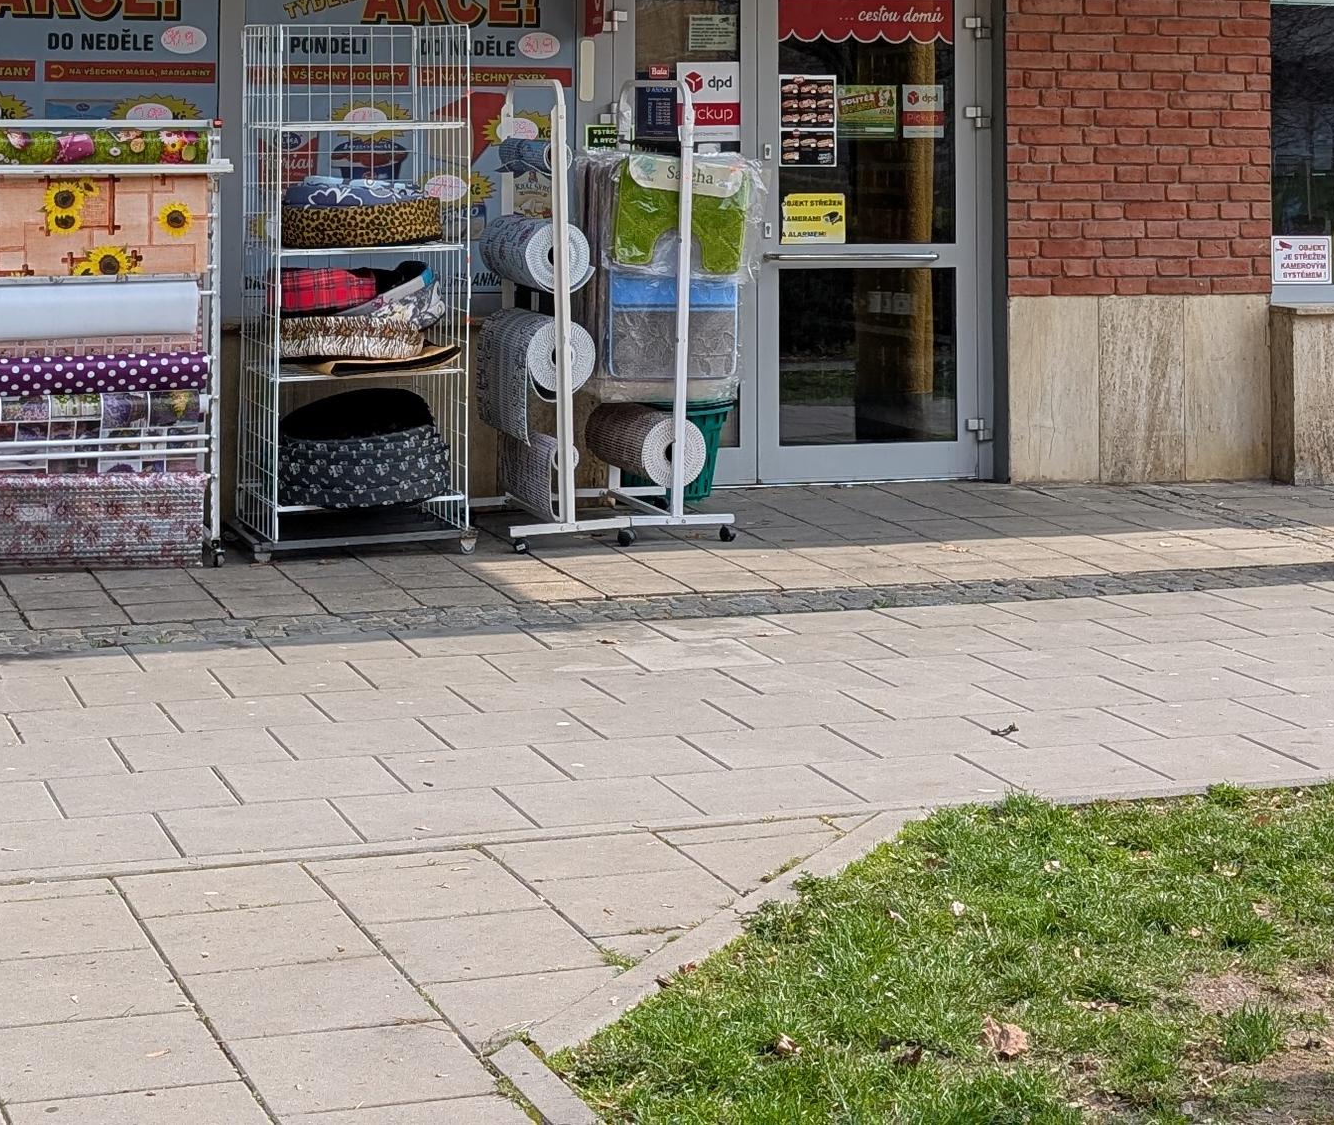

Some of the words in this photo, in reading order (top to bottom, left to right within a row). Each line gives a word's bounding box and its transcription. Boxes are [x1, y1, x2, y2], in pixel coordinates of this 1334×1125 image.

[858, 5, 899, 23] cestou
[903, 6, 944, 23] domů
[47, 32, 74, 51] DO
[81, 28, 154, 52] NEDĚLE
[707, 76, 732, 92] dpd
[922, 92, 938, 104] dpd
[694, 106, 734, 122] ickup
[1294, 252, 1326, 261] STŘEŽEN
[1280, 261, 1326, 270] KAMEROVÝM
